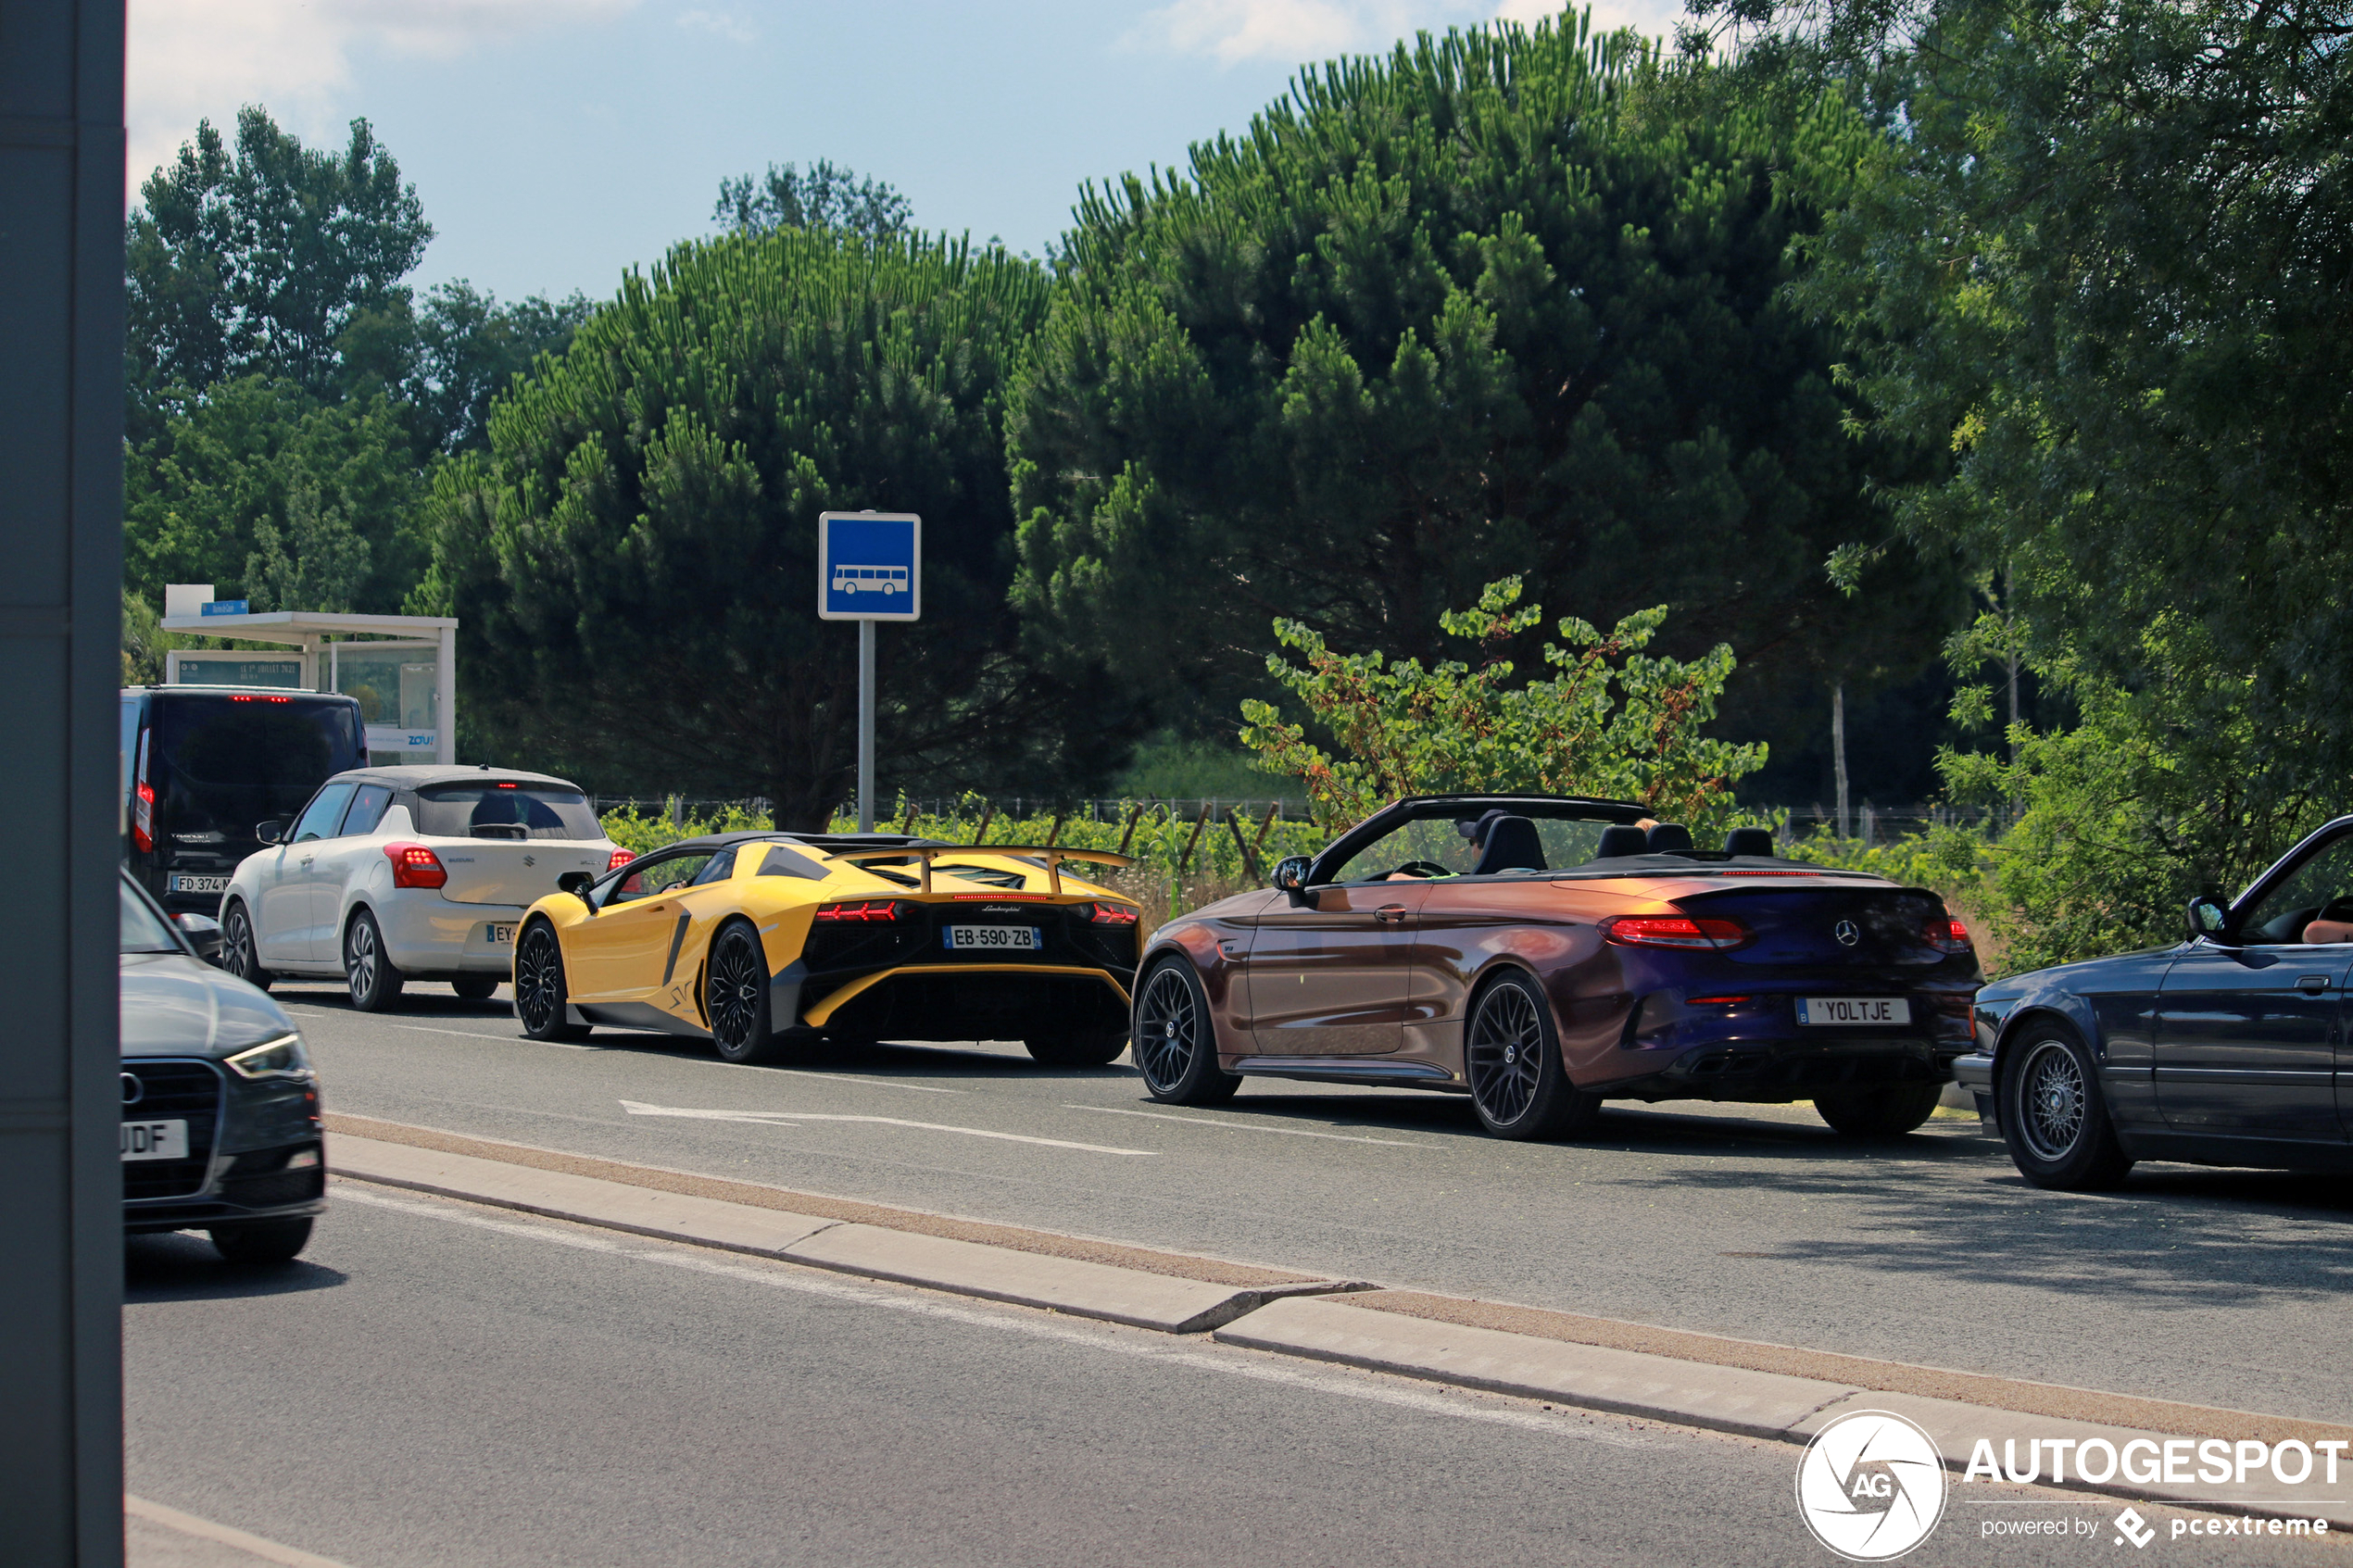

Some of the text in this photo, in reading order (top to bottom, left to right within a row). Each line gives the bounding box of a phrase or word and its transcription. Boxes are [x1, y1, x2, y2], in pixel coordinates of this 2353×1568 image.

[982, 905, 1022, 913] Lamborghini
[954, 929, 1032, 946] EB-590-ZB
[1800, 1013, 1807, 1022] B
[1826, 1001, 1893, 1021] YOLTJE
